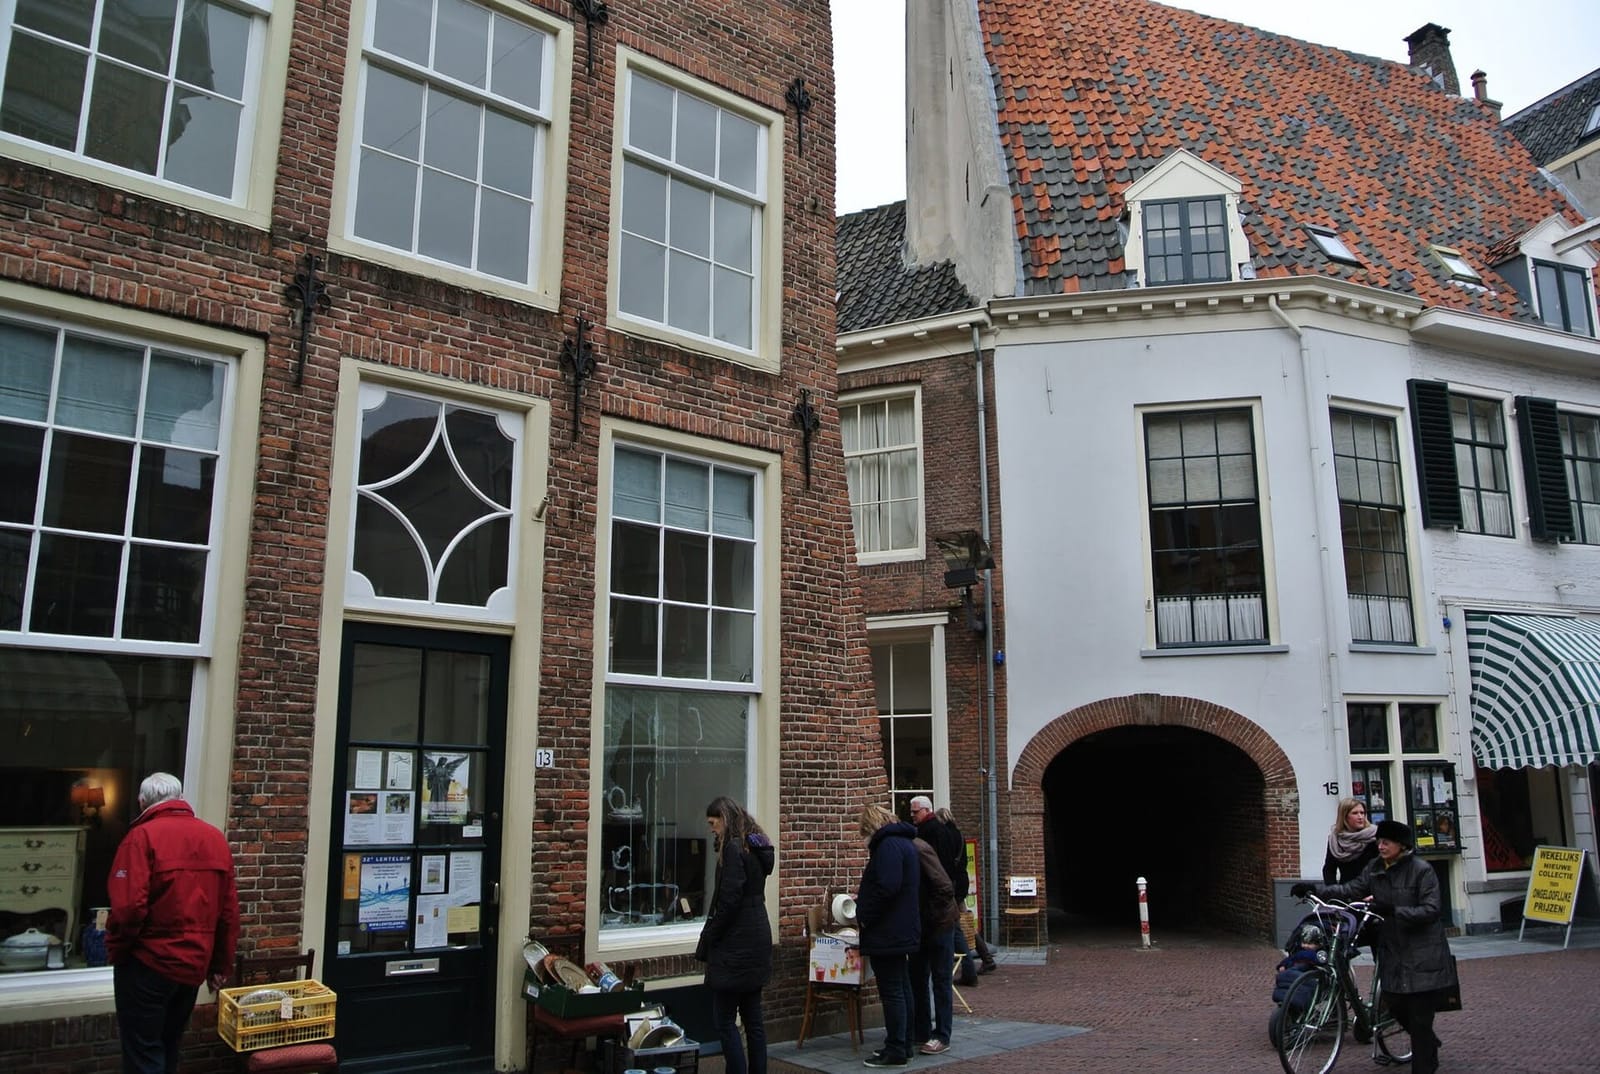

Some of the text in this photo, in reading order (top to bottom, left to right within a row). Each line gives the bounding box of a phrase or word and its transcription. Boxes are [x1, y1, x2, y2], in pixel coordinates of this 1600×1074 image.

[538, 751, 551, 766] 13
[1322, 782, 1339, 796] 15
[1540, 850, 1579, 862] WEKELIJKS
[1543, 863, 1572, 871] NIEUWE
[1538, 870, 1574, 880] COLLECTIE
[816, 937, 839, 946] HILIPS
